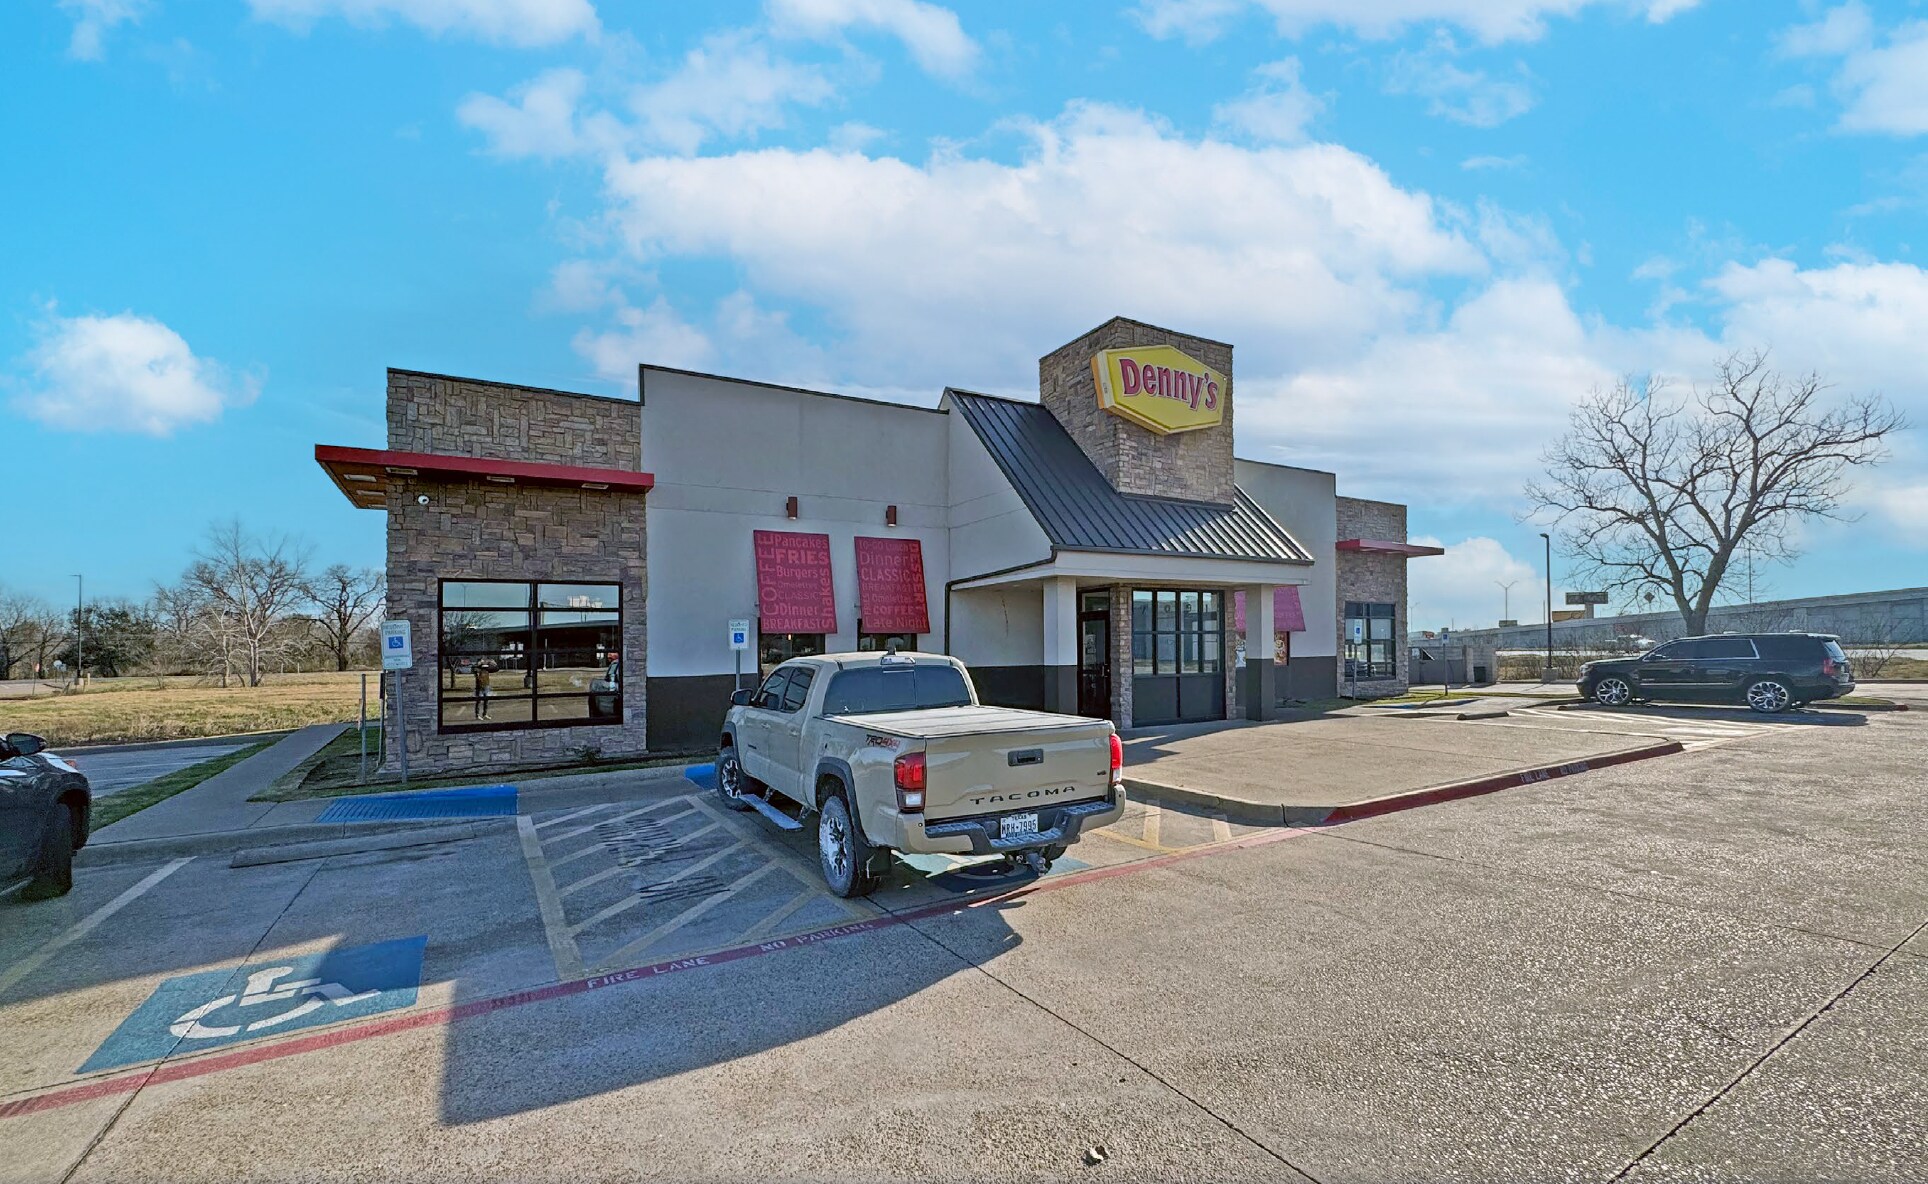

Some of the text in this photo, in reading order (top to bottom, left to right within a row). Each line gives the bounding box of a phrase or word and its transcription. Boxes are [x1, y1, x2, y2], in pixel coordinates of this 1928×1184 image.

[1118, 357, 1219, 411] Denny's
[775, 534, 829, 549] Pancakes
[775, 548, 830, 565] FRIES
[860, 551, 909, 566] Dinner
[758, 533, 779, 616] COFFEE
[776, 565, 818, 580] Burgers
[861, 568, 910, 582] CLASSIC
[909, 543, 927, 616] DESSERT
[862, 582, 912, 592] BREAKFAST
[778, 591, 820, 600] CLASSIC
[820, 568, 835, 629] Shakes
[779, 602, 818, 616] Dinner
[873, 605, 914, 615] COFFEE
[763, 618, 821, 630] BREAKFAST
[865, 616, 927, 630] Late Night
[969, 786, 1075, 805] TACOMA
[586, 923, 875, 989] FIRE LANE NO PARKING
